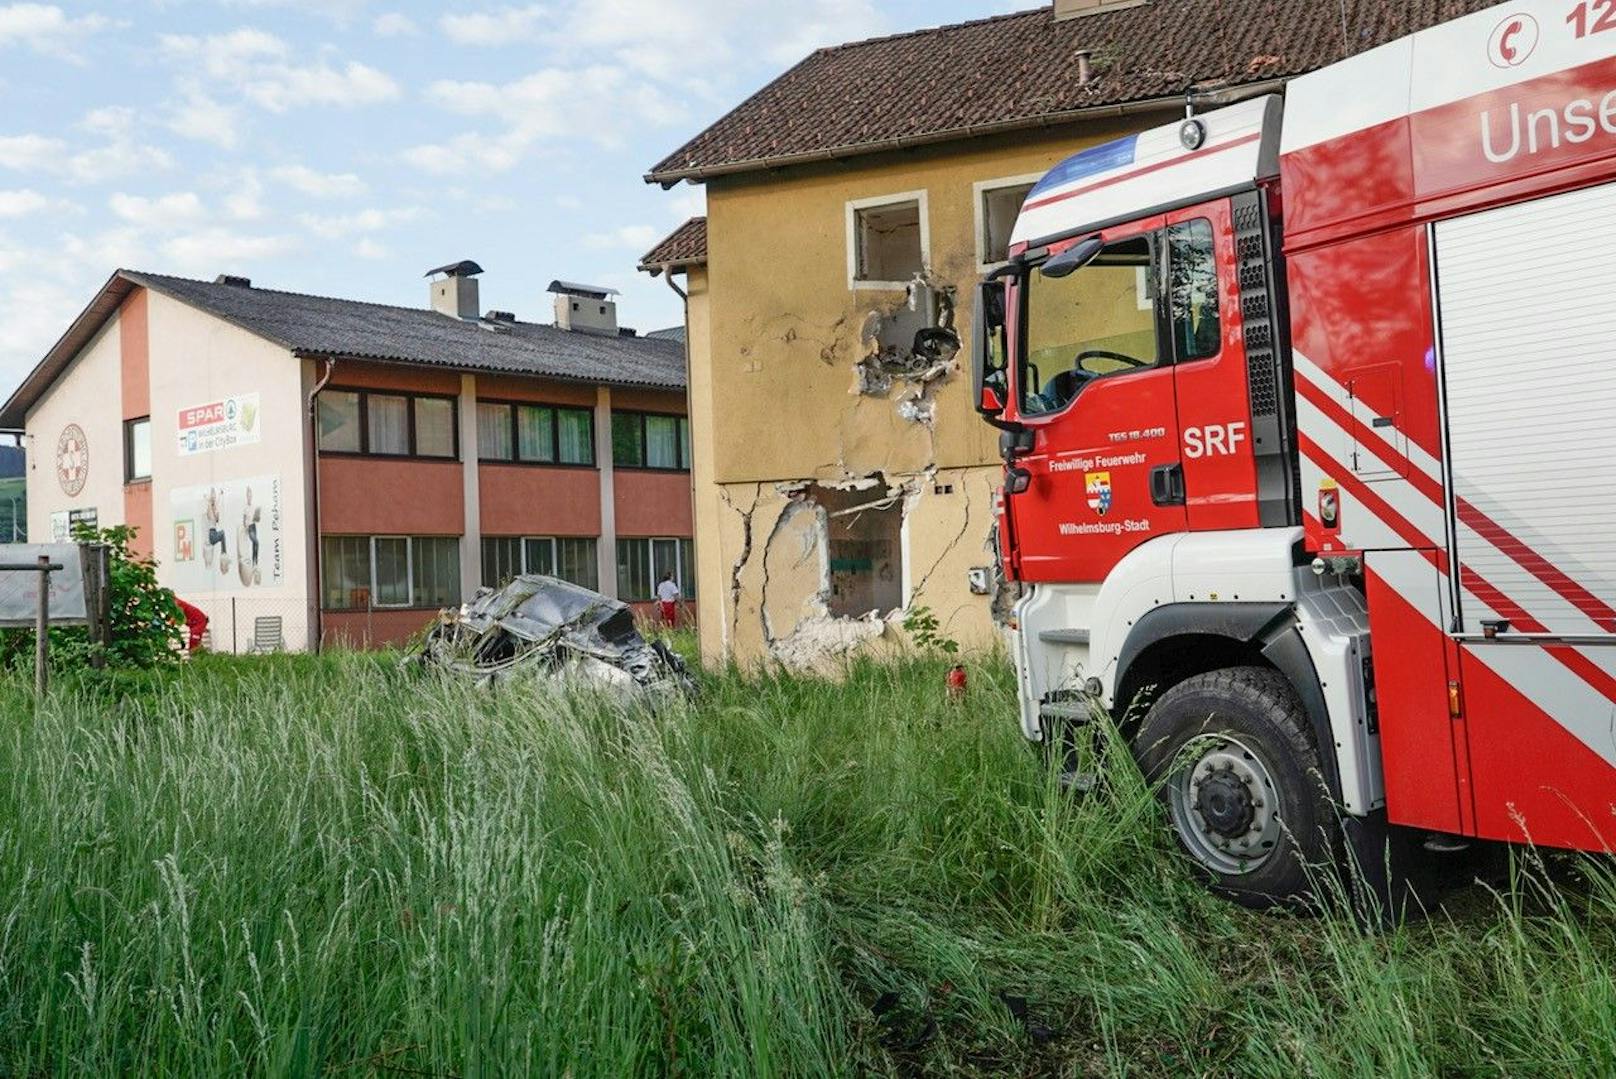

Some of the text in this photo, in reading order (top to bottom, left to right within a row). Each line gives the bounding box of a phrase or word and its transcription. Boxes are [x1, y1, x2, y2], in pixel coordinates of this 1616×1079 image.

[186, 405, 224, 425] SPAR
[1109, 427, 1165, 442] TGS 18.400
[1183, 422, 1245, 458] SRF
[1049, 451, 1147, 473] Freiwillige Feuerwehr
[1059, 518, 1150, 536] Wilhelmsburg-Stadt
